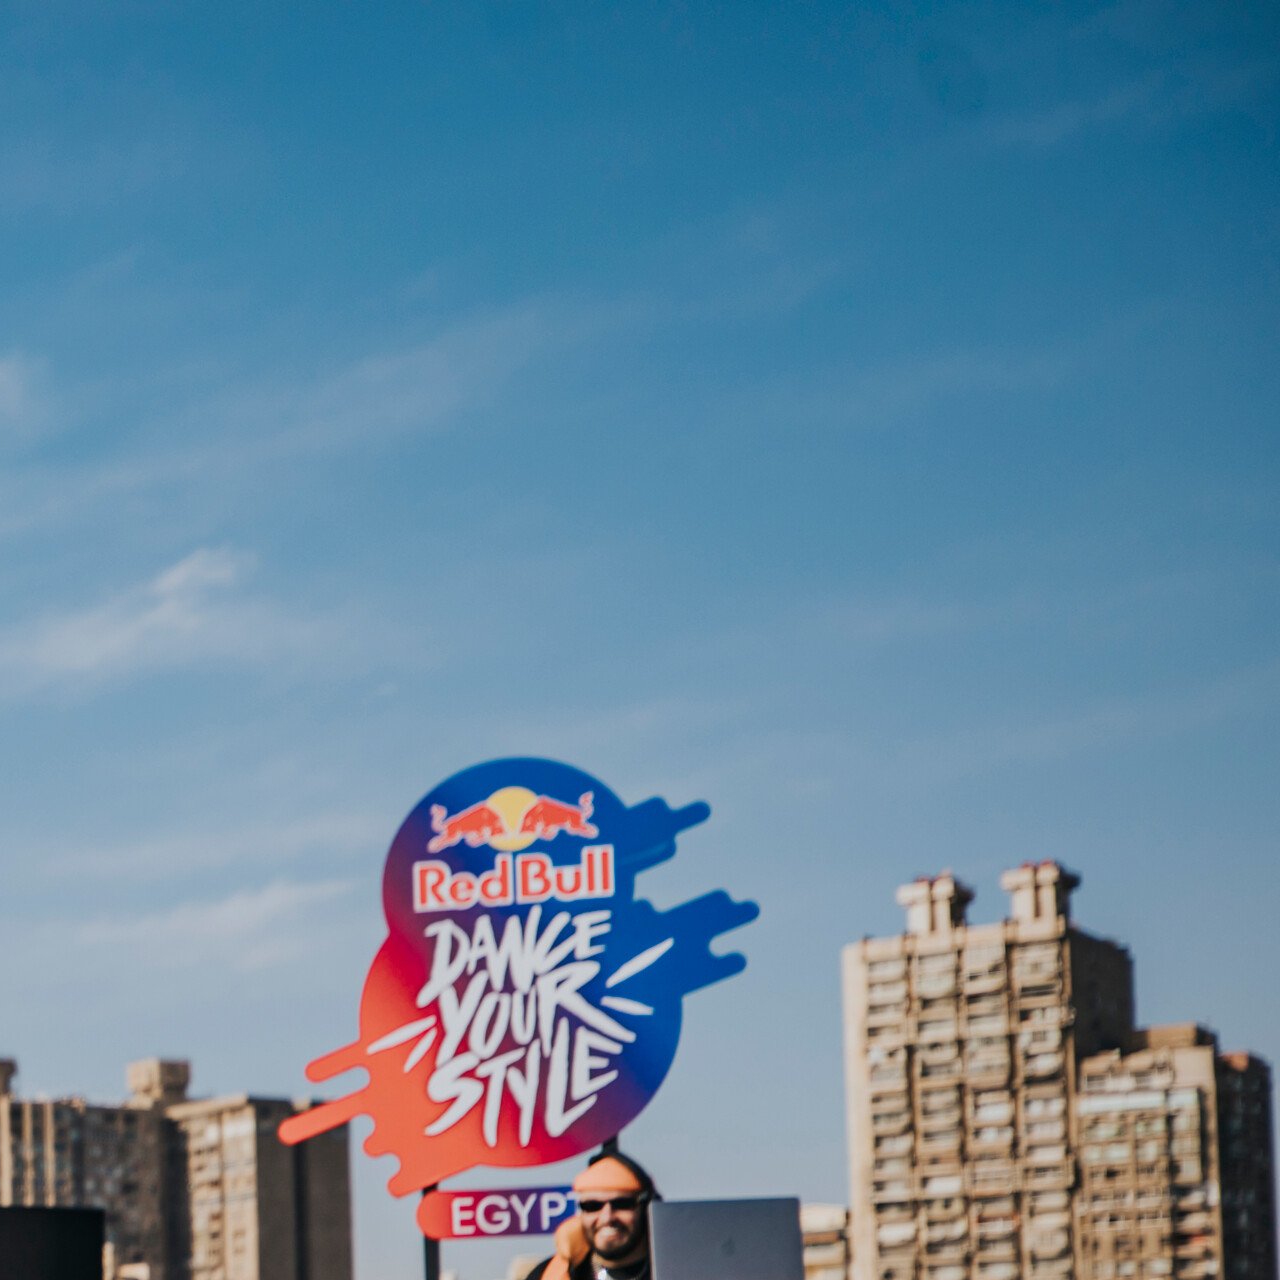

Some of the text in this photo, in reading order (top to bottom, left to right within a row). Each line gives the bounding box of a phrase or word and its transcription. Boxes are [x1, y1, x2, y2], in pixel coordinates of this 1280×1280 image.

[414, 847, 613, 909] Red Bull
[417, 905, 611, 1008] DANCE
[436, 960, 636, 1072] YOUR
[425, 1016, 624, 1148] STYLE
